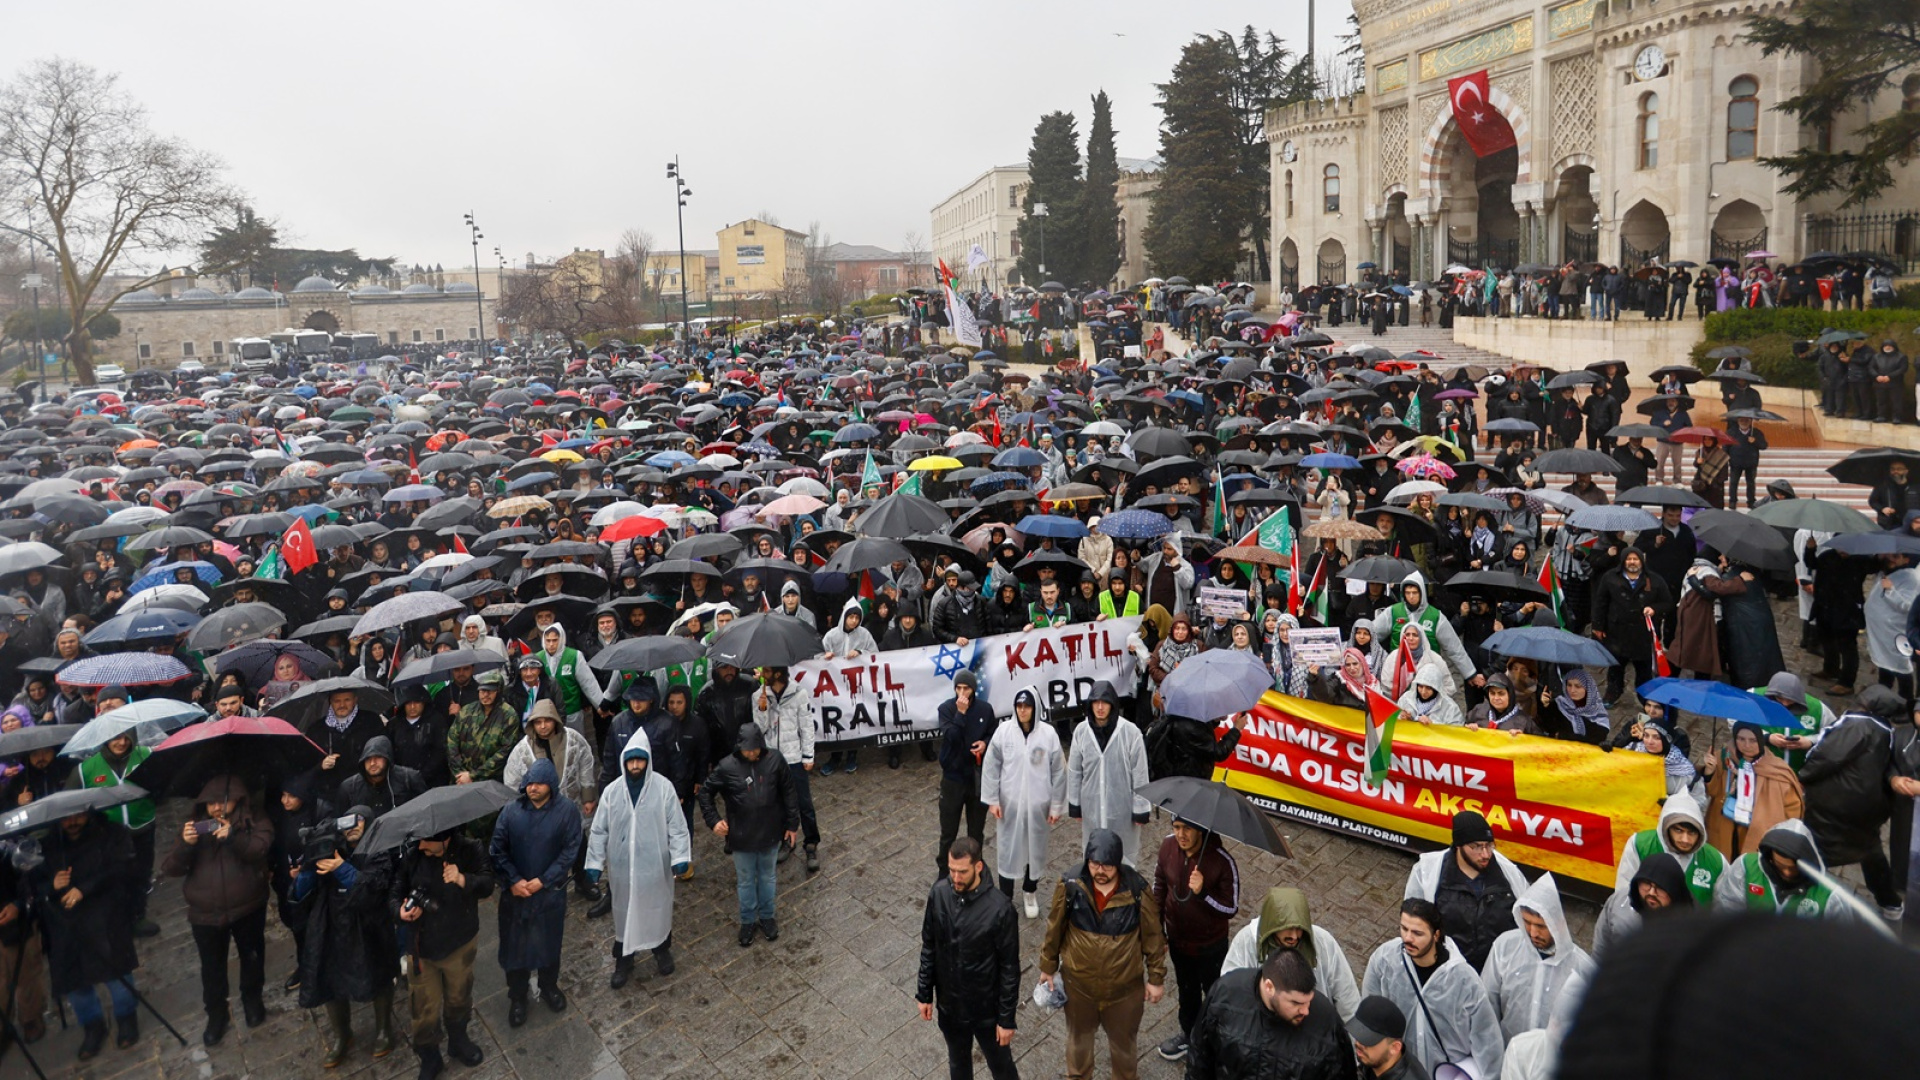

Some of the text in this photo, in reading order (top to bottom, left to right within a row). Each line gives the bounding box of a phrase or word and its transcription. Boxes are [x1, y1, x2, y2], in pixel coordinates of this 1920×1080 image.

[1005, 624, 1123, 677] KATİL
[812, 692, 913, 736] RAİL
[1033, 677, 1096, 708] BD
[1233, 744, 1292, 777] EDA
[1346, 741, 1489, 792] CNIMIZ
[1279, 803, 1339, 827] DAYANIŞMA
[1341, 820, 1408, 845] PLATFORMU
